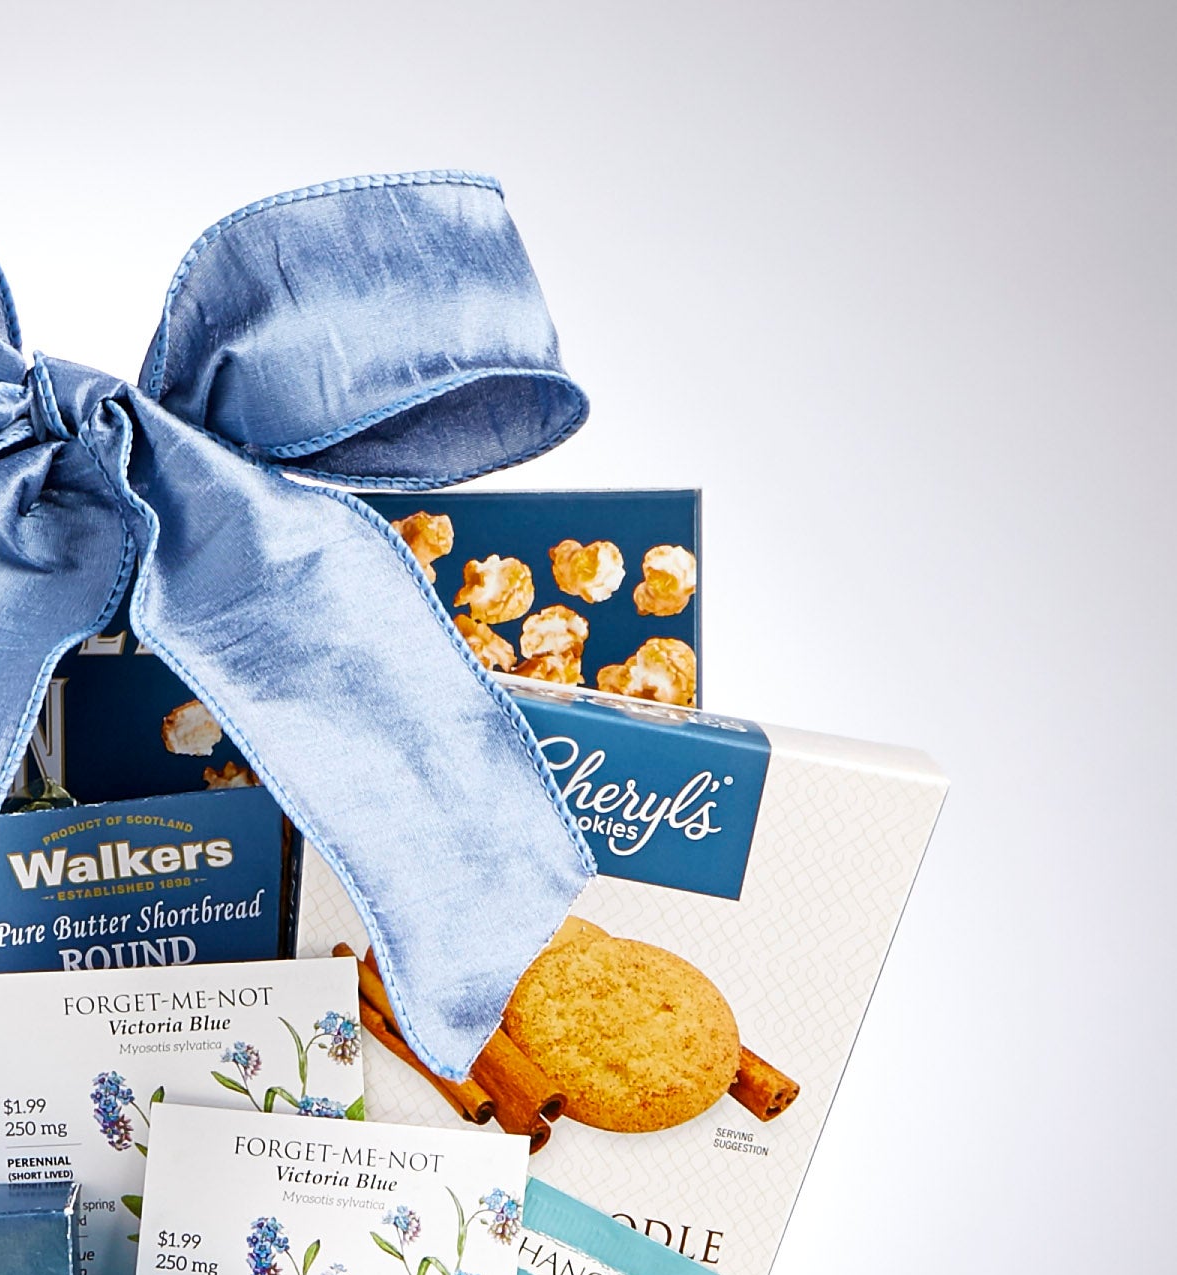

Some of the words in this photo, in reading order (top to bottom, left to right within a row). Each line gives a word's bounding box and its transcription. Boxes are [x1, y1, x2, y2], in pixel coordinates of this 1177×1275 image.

[42, 818, 102, 846] PRODUCT
[106, 815, 123, 827] OF
[126, 815, 194, 834] SCOTLAND
[7, 838, 234, 891] Walkers
[57, 881, 155, 902] ESTABLISHED
[52, 913, 131, 941] Butter
[136, 888, 265, 933] Shortbread
[59, 936, 197, 972] ROUND
[63, 986, 273, 1016] FORGET-ME-NOT
[108, 1017, 183, 1036] Victoria
[190, 1015, 232, 1032] Blue
[119, 1041, 171, 1055] Myosotis
[173, 1039, 222, 1053] sylvatica
[3, 1098, 47, 1116] $1.99
[5, 1121, 37, 1137] 250
[41, 1122, 68, 1138] mg
[715, 1127, 755, 1142] SERVING
[234, 1135, 445, 1174] FORGET-ME-NOT
[713, 1138, 769, 1156] SUGGESTION
[7, 1156, 72, 1168] PERENNIAL
[8, 1171, 42, 1182] (SHORT
[44, 1169, 74, 1180] LIVED)
[276, 1165, 350, 1188] Victoria
[355, 1173, 398, 1192] Blue
[82, 1198, 116, 1213] spring
[282, 1190, 335, 1207] Myosotis
[336, 1194, 385, 1211] sylvatica
[157, 1230, 202, 1249] $1.99
[155, 1253, 187, 1271] 250
